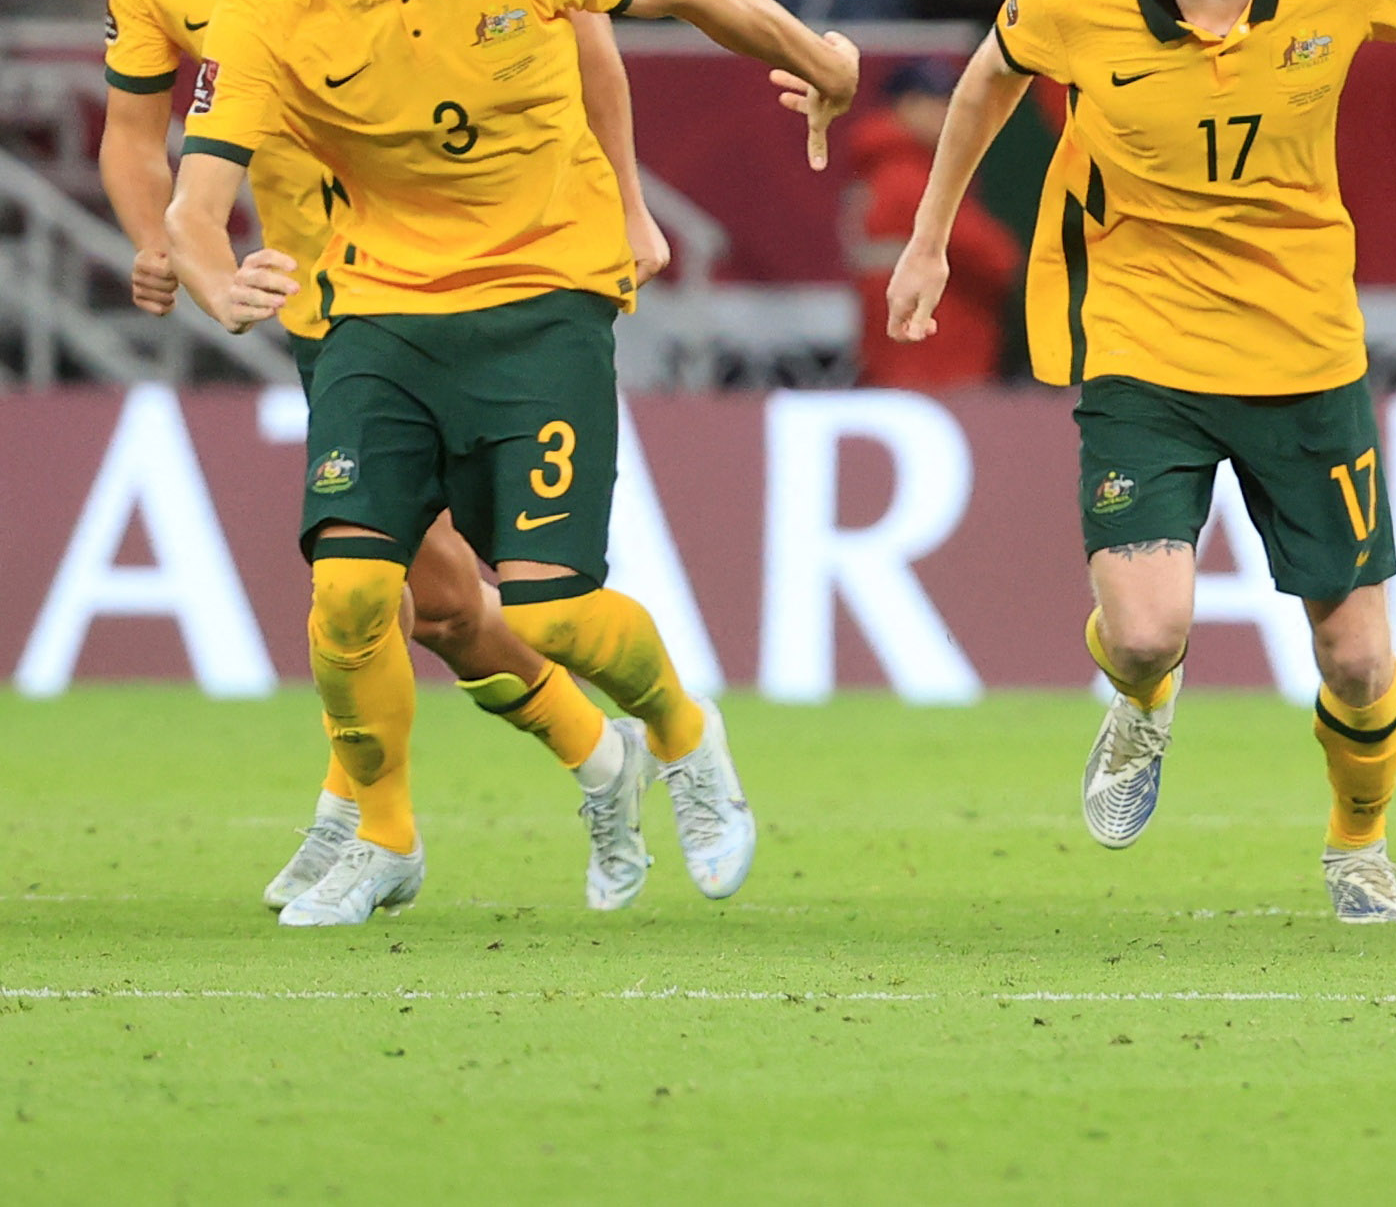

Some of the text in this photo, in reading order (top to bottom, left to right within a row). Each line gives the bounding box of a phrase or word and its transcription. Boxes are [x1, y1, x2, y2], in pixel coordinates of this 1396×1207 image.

[433, 100, 479, 155] 3
[1198, 114, 1262, 183] 17
[529, 420, 577, 499] 3
[1330, 446, 1376, 541] 17
[14, 384, 985, 705] AR
